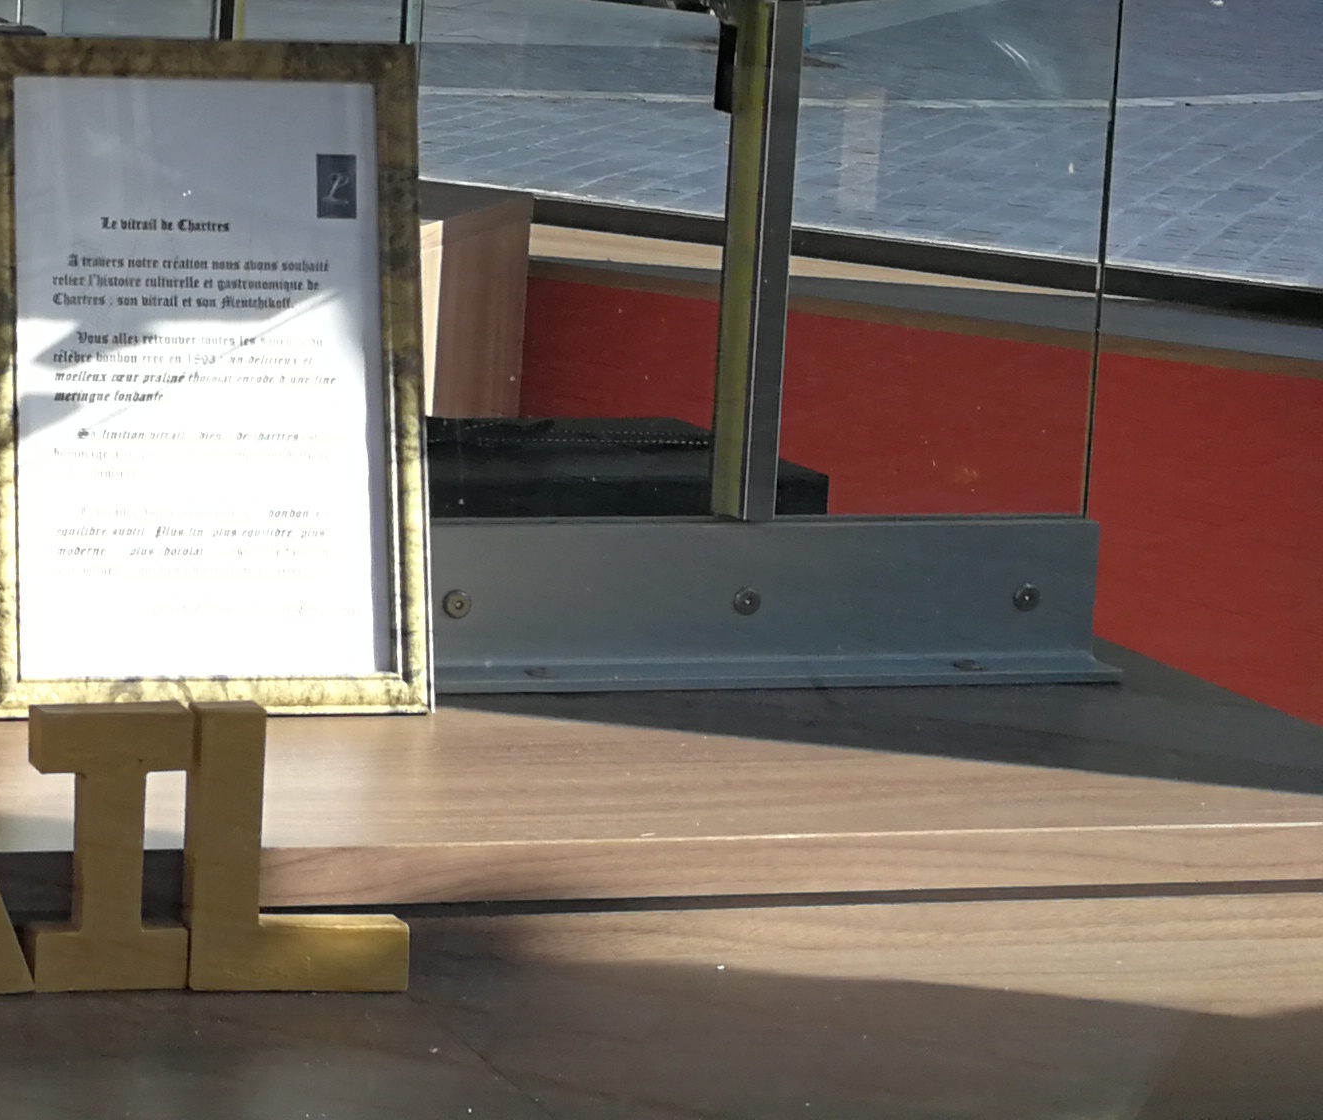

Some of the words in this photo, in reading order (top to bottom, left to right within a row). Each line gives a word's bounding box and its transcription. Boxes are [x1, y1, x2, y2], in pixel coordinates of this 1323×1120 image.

[100, 216, 117, 230] Le
[120, 218, 157, 231] vitrail
[160, 218, 173, 231] de
[177, 218, 230, 232] Chartres
[68, 253, 78, 268] A
[82, 257, 125, 268] travers
[127, 258, 160, 269] notre
[211, 260, 240, 271] nous
[243, 260, 278, 272] avons
[52, 273, 85, 286] relier
[145, 276, 200, 289] culturelle
[203, 279, 213, 289] et
[217, 279, 303, 292] gastronomique
[306, 278, 320, 290] de
[52, 292, 106, 306] Chartres
[117, 296, 138, 307] son
[141, 295, 178, 307] vitrail
[182, 296, 192, 307] et
[196, 297, 217, 308] son
[76, 331, 109, 345] Vous
[112, 333, 139, 345] allez
[142, 334, 196, 346] retrouver
[202, 337, 236, 347] toutes
[239, 336, 256, 347] les
[96, 352, 137, 364] bonbon
[55, 370, 107, 382] moelleux
[55, 389, 111, 404] meringue
[113, 390, 164, 402] fondante
[102, 429, 145, 440] finition
